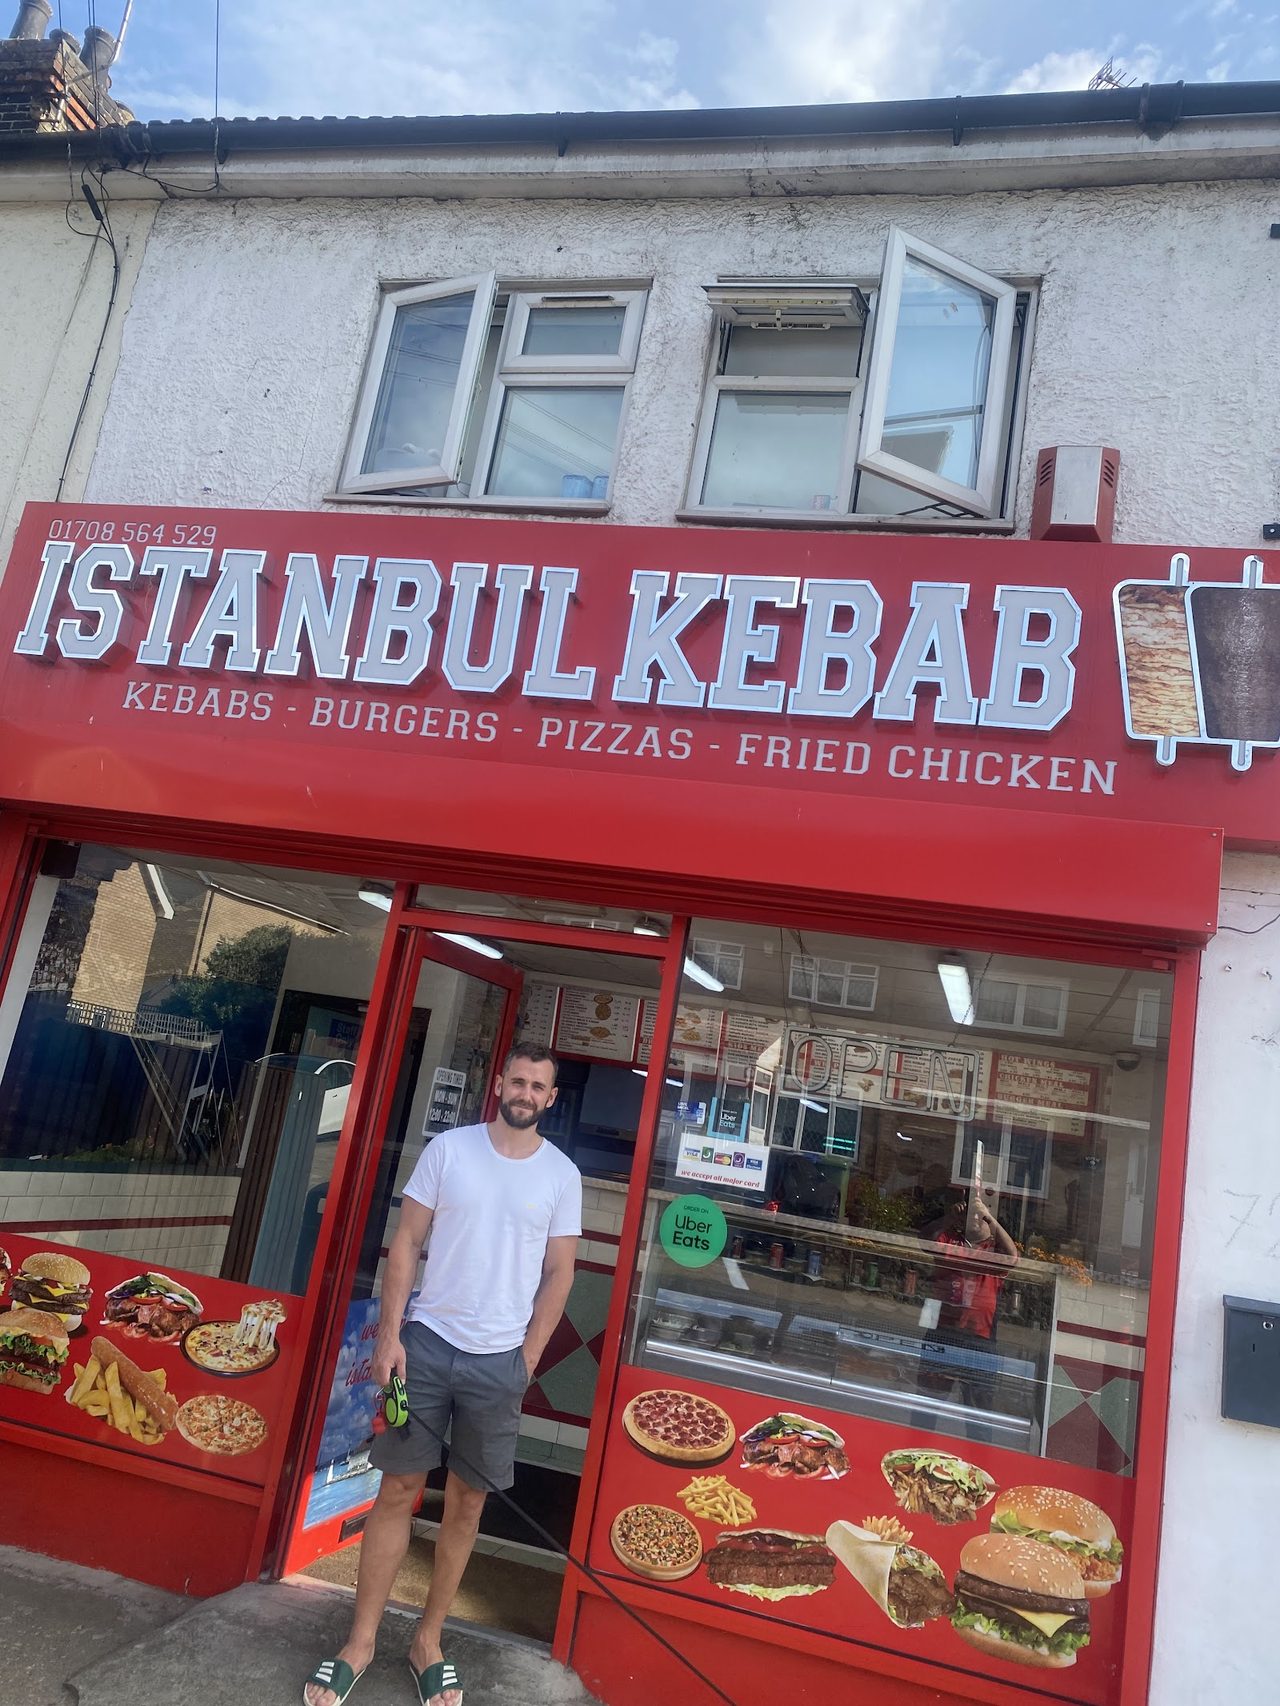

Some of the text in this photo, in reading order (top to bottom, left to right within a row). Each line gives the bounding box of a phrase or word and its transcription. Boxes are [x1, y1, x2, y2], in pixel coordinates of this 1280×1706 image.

[48, 519, 217, 546] 01708 564 529
[13, 540, 1083, 732] ISTANBUL KEBAB
[122, 681, 275, 722] KEBABS
[309, 696, 501, 743] BURGERS
[536, 716, 694, 760] PIZZAS
[736, 733, 872, 776] FRIED
[887, 745, 1118, 796] CHICKEN
[1001, 1054, 1056, 1068] HOT WINGS
[791, 1035, 974, 1115] OPEN
[999, 1073, 1064, 1088] CHICKEN MEAL
[719, 1120, 736, 1129] Eats
[720, 1112, 737, 1122] Uber
[691, 1171, 713, 1181] accept
[722, 1177, 743, 1185] major
[743, 1180, 760, 1188] card
[684, 1205, 699, 1213] ORDER
[675, 1214, 712, 1234] Uber
[672, 1230, 710, 1250] Eats
